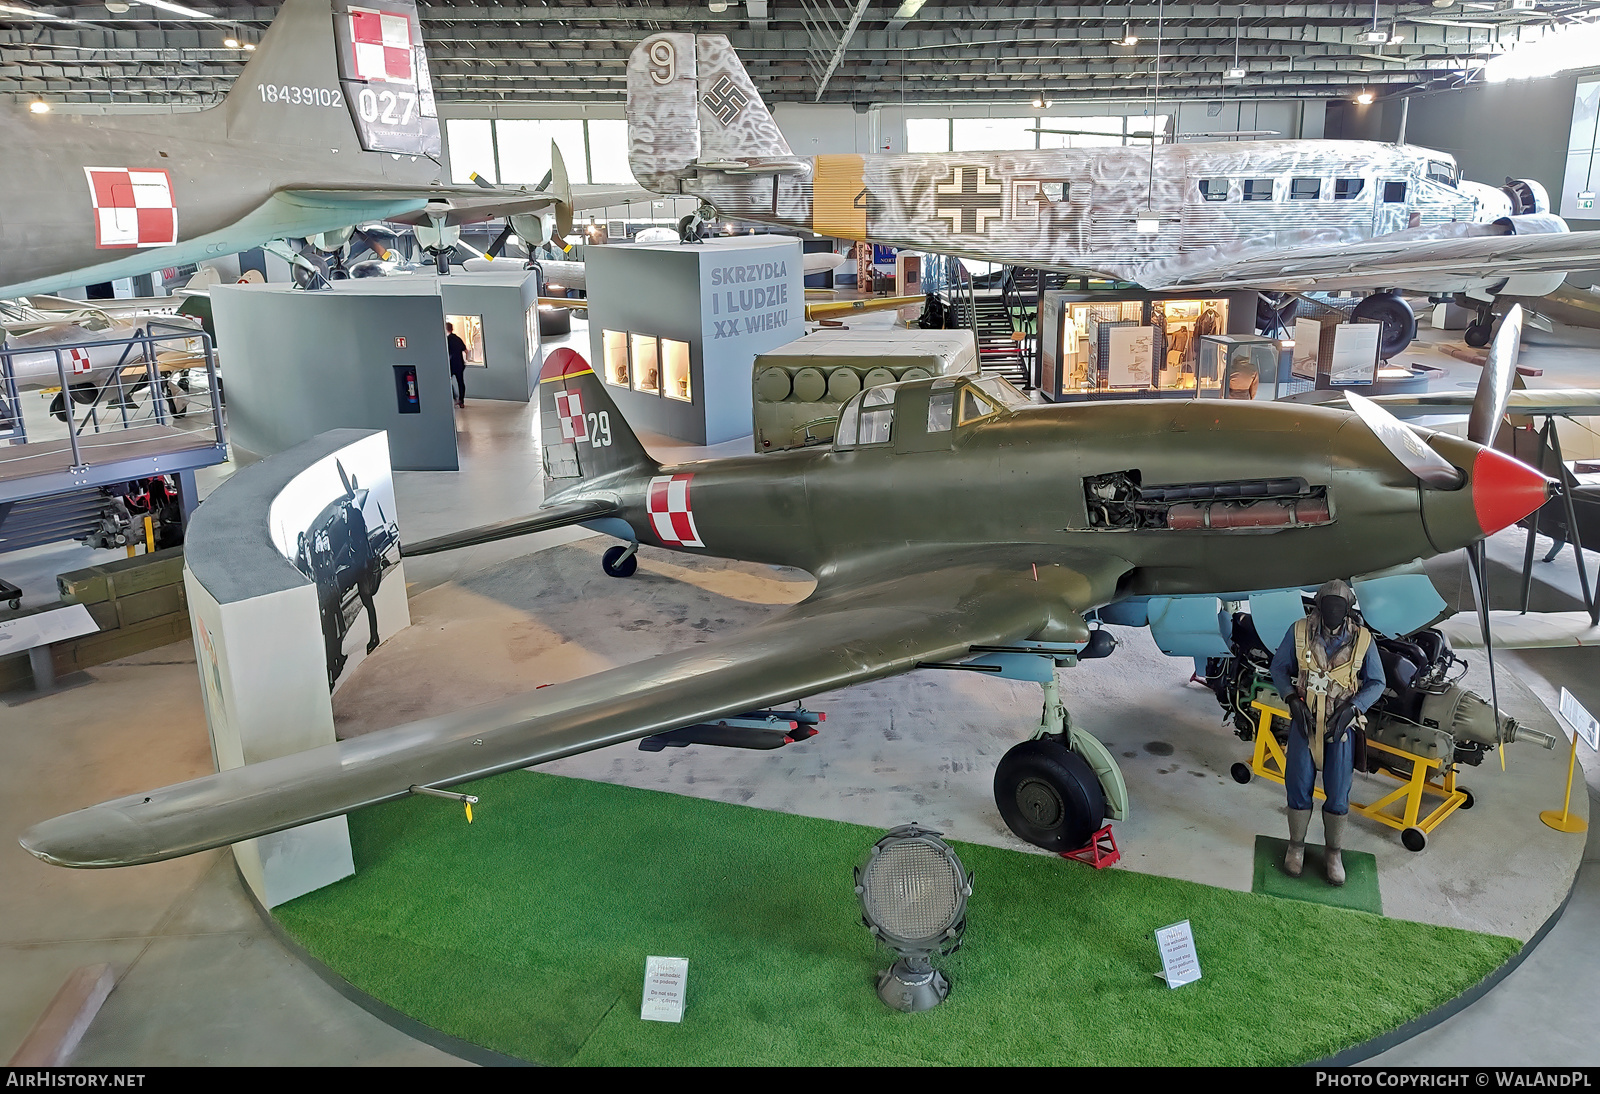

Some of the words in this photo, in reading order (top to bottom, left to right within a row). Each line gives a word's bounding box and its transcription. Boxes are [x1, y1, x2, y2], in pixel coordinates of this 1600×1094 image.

[650, 40, 675, 85] 9
[257, 83, 343, 108] 18439102
[358, 88, 416, 126] 027
[711, 260, 787, 286] SKRZYDŁA
[712, 292, 719, 315] I
[726, 283, 788, 313] LUDZIE
[713, 318, 740, 340] XX
[744, 308, 788, 335] WIEKU
[587, 410, 612, 448] 29
